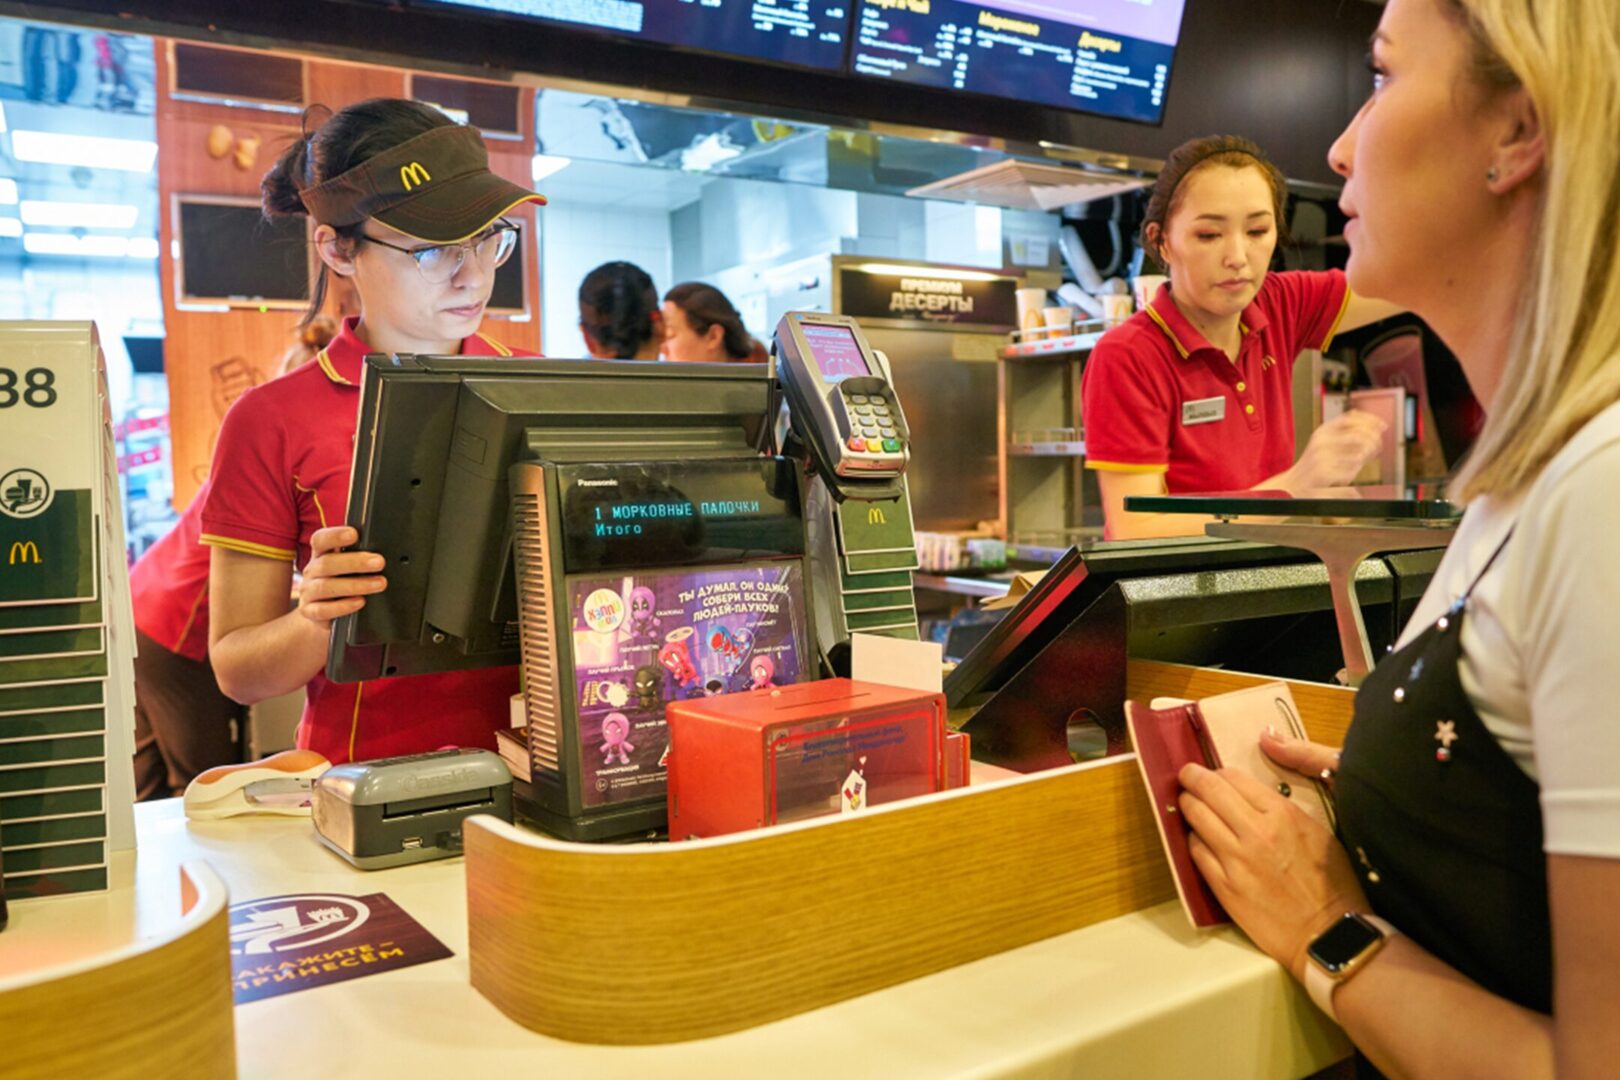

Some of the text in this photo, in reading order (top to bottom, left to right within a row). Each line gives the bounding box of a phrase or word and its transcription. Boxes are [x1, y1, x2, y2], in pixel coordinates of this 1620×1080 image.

[889, 292, 974, 312] ДЕСЕРТЫ
[577, 479, 618, 487] Panasonic
[595, 501, 760, 520] 1 МОРКОВНЫЕ ПАЛОЧКИ
[595, 523, 642, 536] Итого
[678, 589, 695, 603] ТЫ
[740, 581, 755, 591] ОН
[703, 592, 769, 607] СОБЕРИ ВСЕХ
[693, 603, 779, 622] ЛЮДЕЙ-ПАУКОВ!
[234, 944, 374, 980] АКАЖИТЕ
